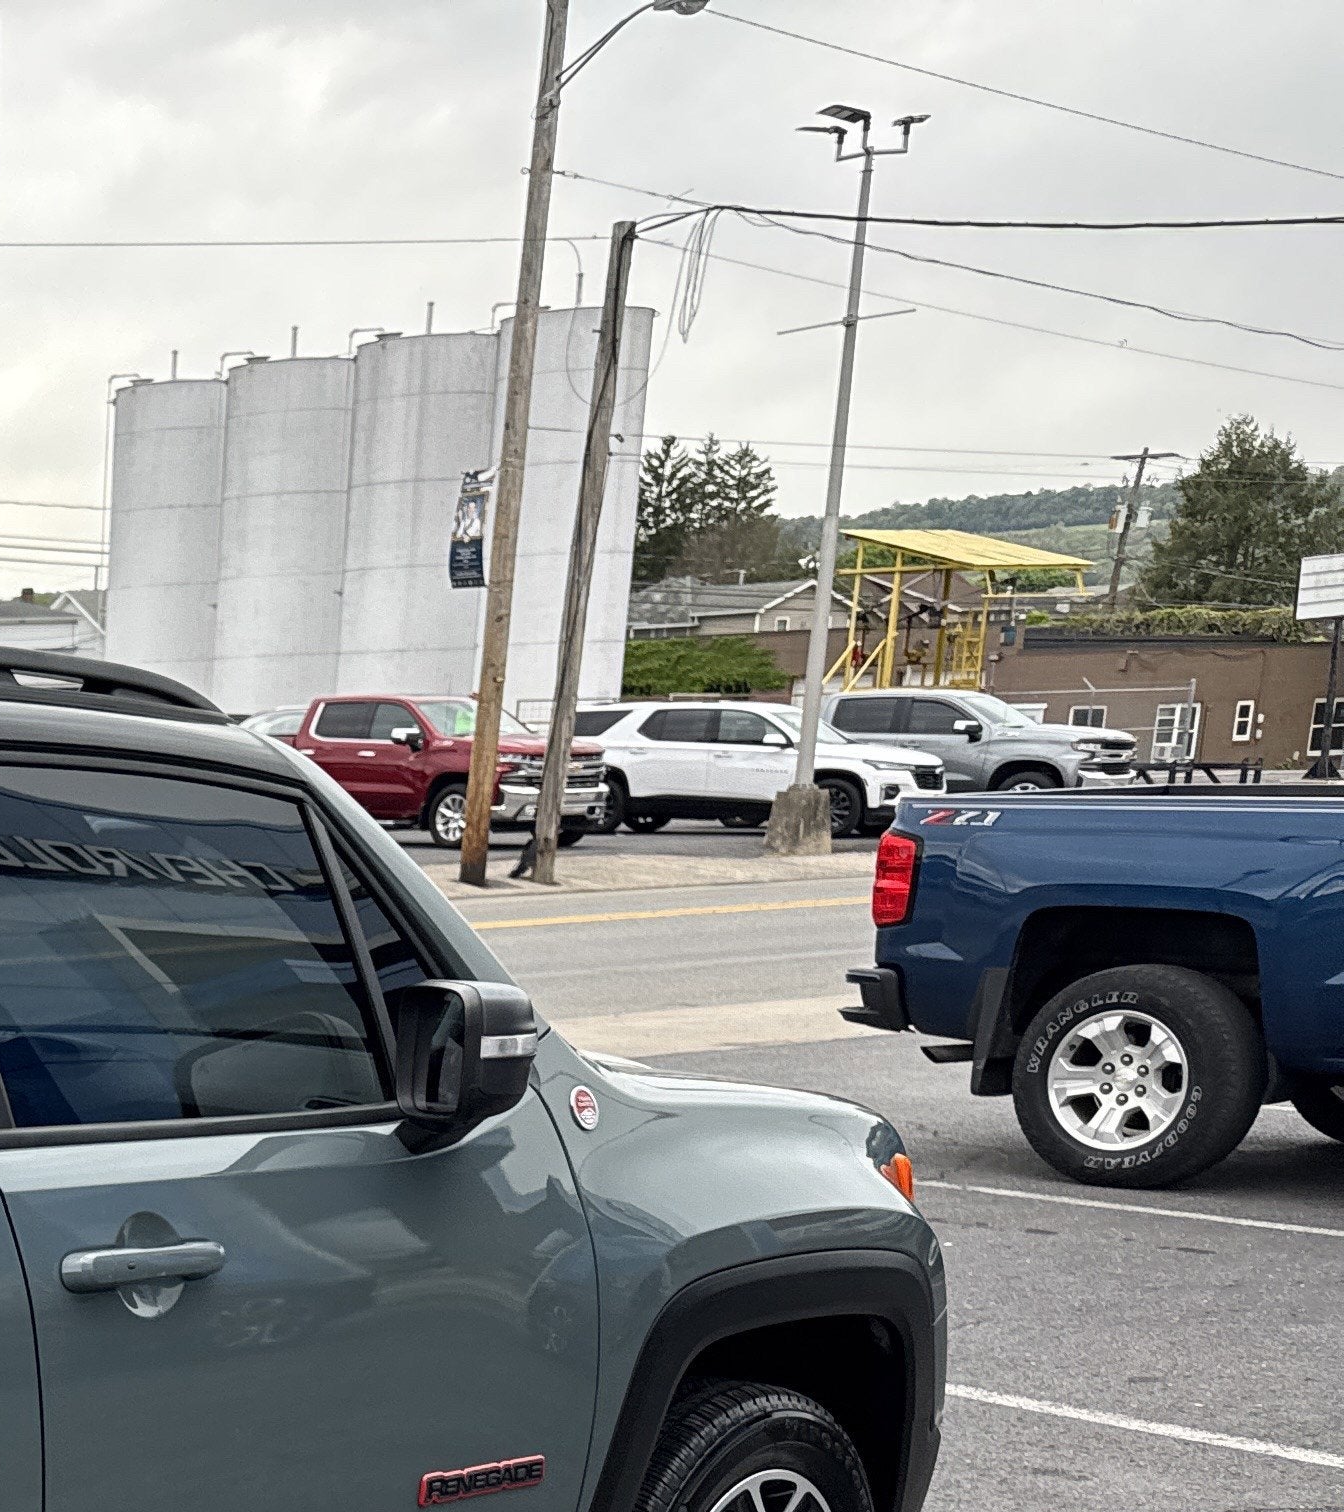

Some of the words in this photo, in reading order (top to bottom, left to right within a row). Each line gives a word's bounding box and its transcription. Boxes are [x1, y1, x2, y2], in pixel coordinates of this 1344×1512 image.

[919, 808, 1002, 827] Z71
[1026, 991, 1139, 1074] WRANGLER
[1083, 1085, 1203, 1170] GOODYEAR
[422, 1459, 544, 1503] RENEGADE
